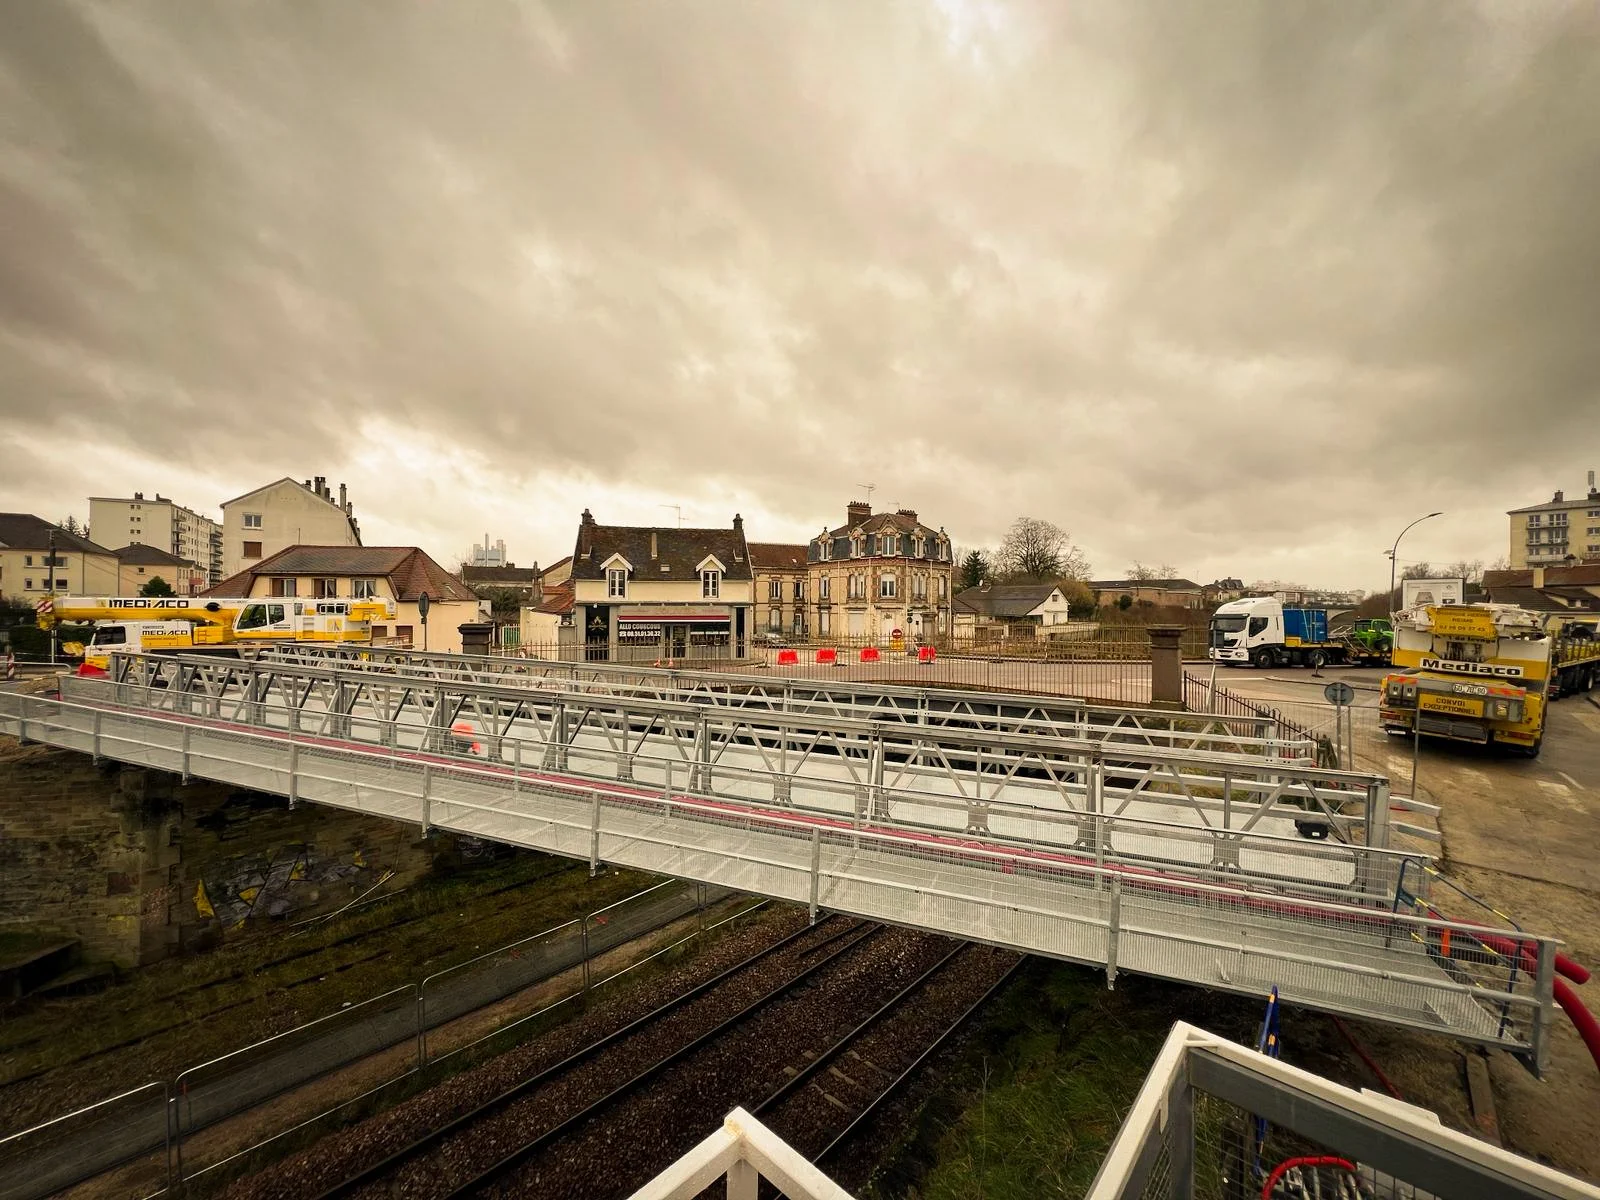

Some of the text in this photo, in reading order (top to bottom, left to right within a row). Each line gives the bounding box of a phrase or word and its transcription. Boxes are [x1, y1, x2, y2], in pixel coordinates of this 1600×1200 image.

[1422, 658, 1521, 676] Mediaco
[1423, 702, 1477, 715] EXCEPTIONNEL
[1435, 697, 1466, 707] CONVOI
